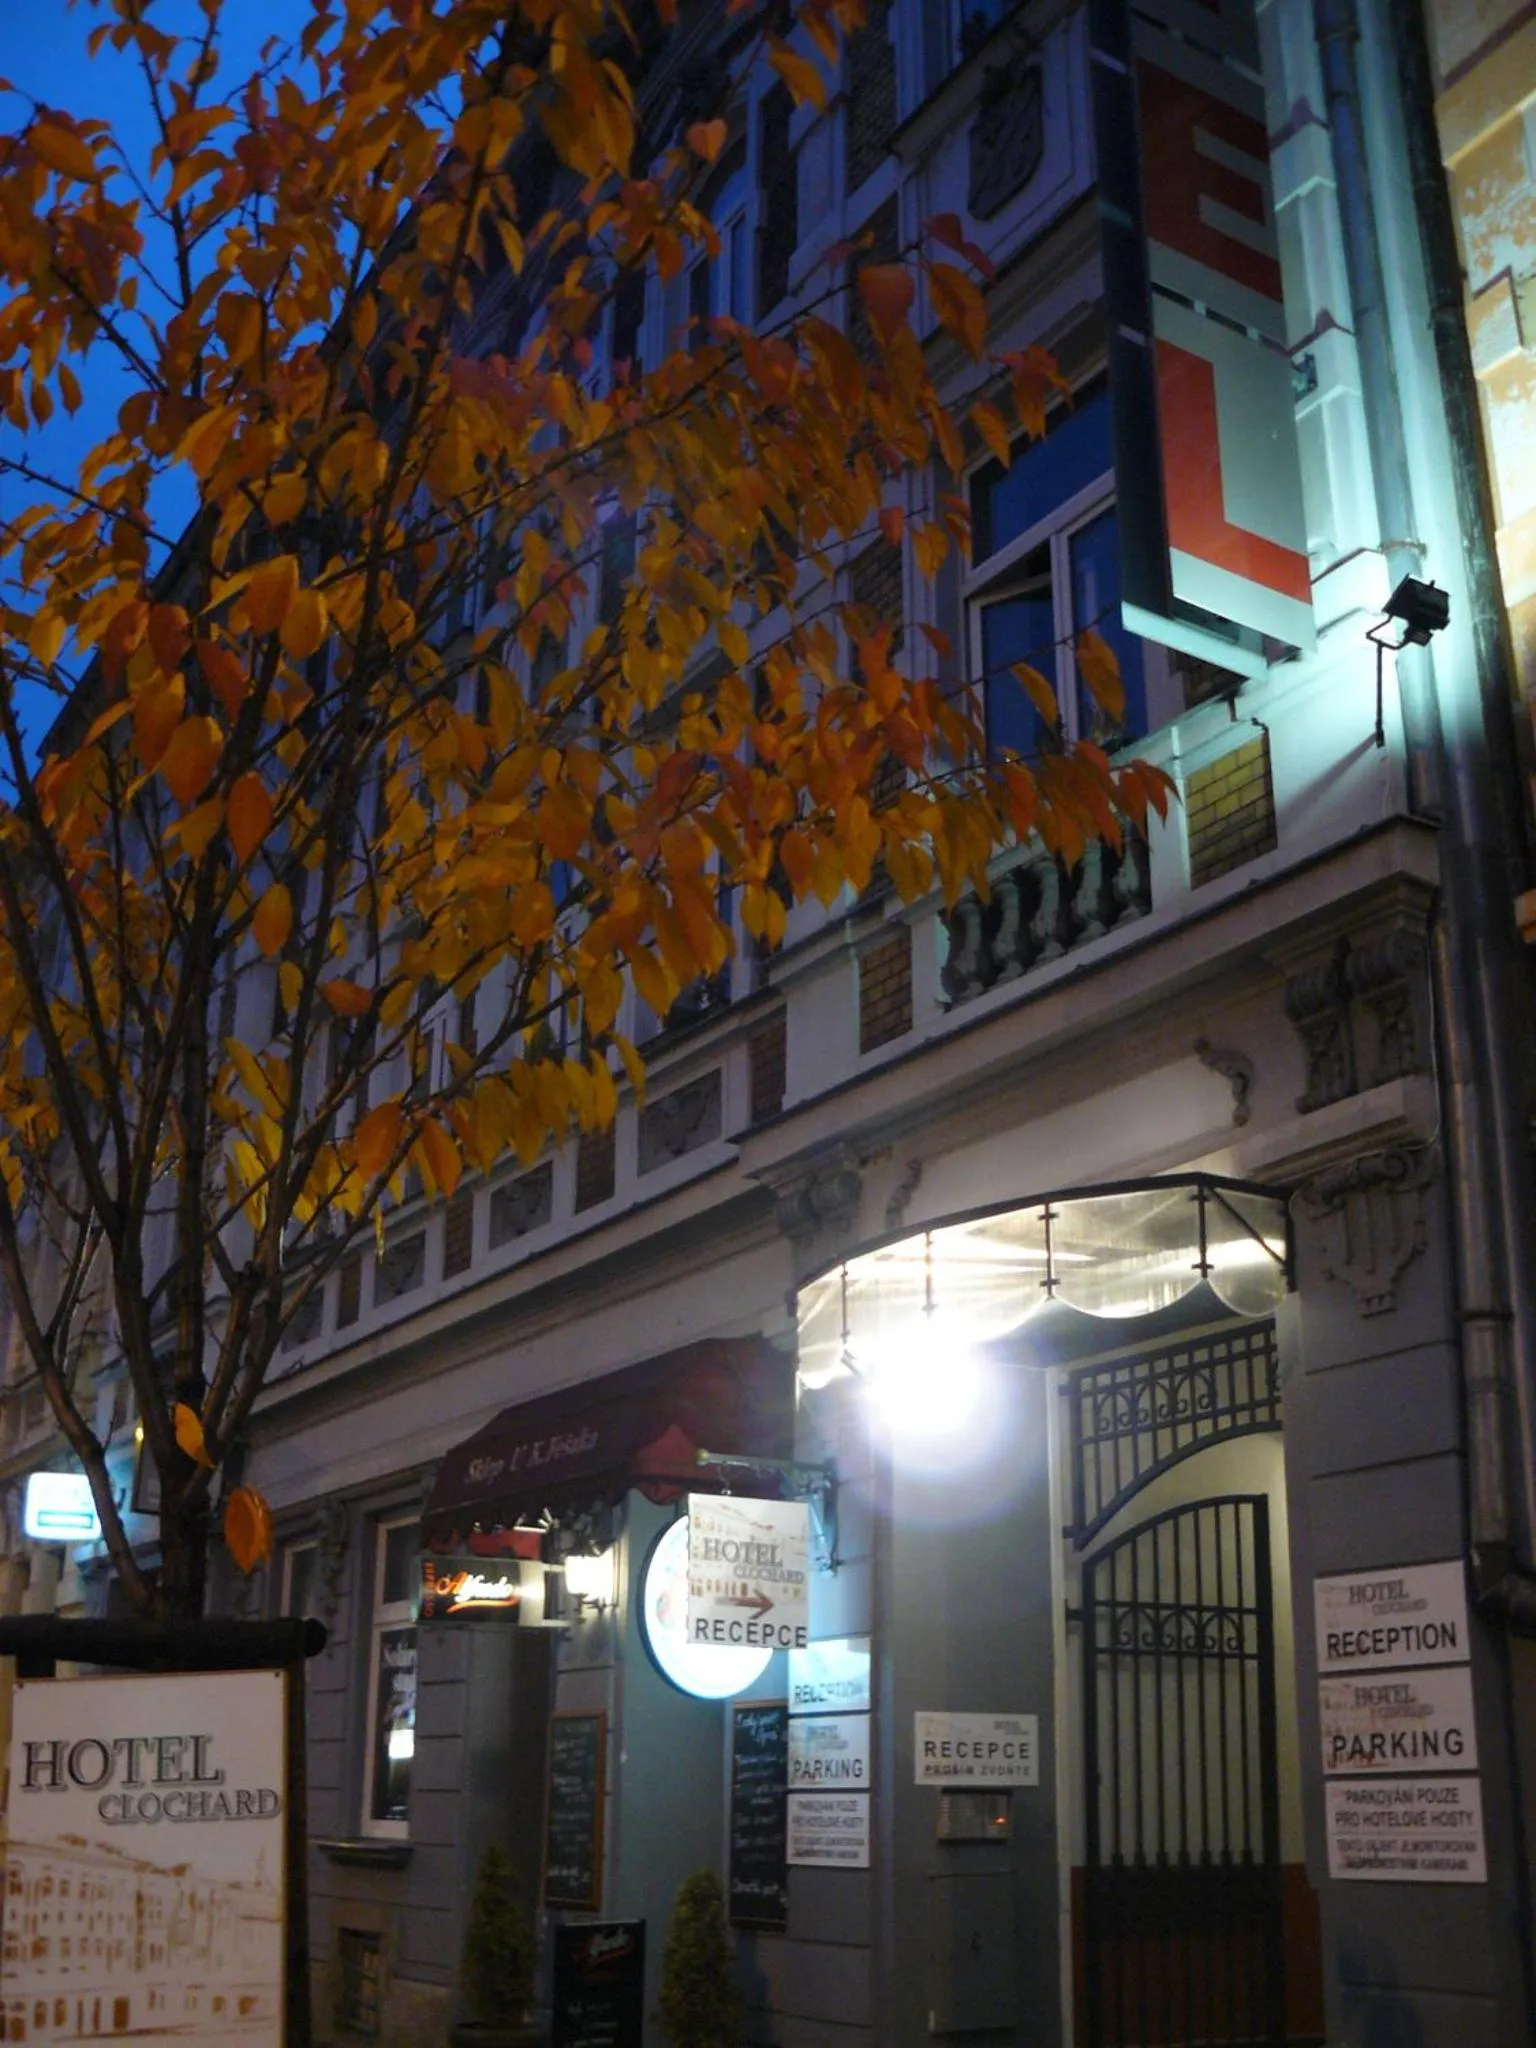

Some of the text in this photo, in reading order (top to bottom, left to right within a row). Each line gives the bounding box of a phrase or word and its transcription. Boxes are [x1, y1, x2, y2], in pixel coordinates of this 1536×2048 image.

[1137, 0, 1312, 605] EL
[703, 1537, 783, 1567] HOTEL
[1349, 1578, 1409, 1605] HOTEL
[695, 1618, 808, 1648] RECEPCE
[1327, 1621, 1458, 1660] RECEPTION
[1355, 1683, 1416, 1707] HOTEL
[924, 1740, 1031, 1760] RECEPCE
[1333, 1728, 1464, 1763] PARKING
[20, 1735, 226, 1792] HOTEL
[793, 1758, 864, 1779] PARKING
[97, 1788, 281, 1825] CLOCHARD
